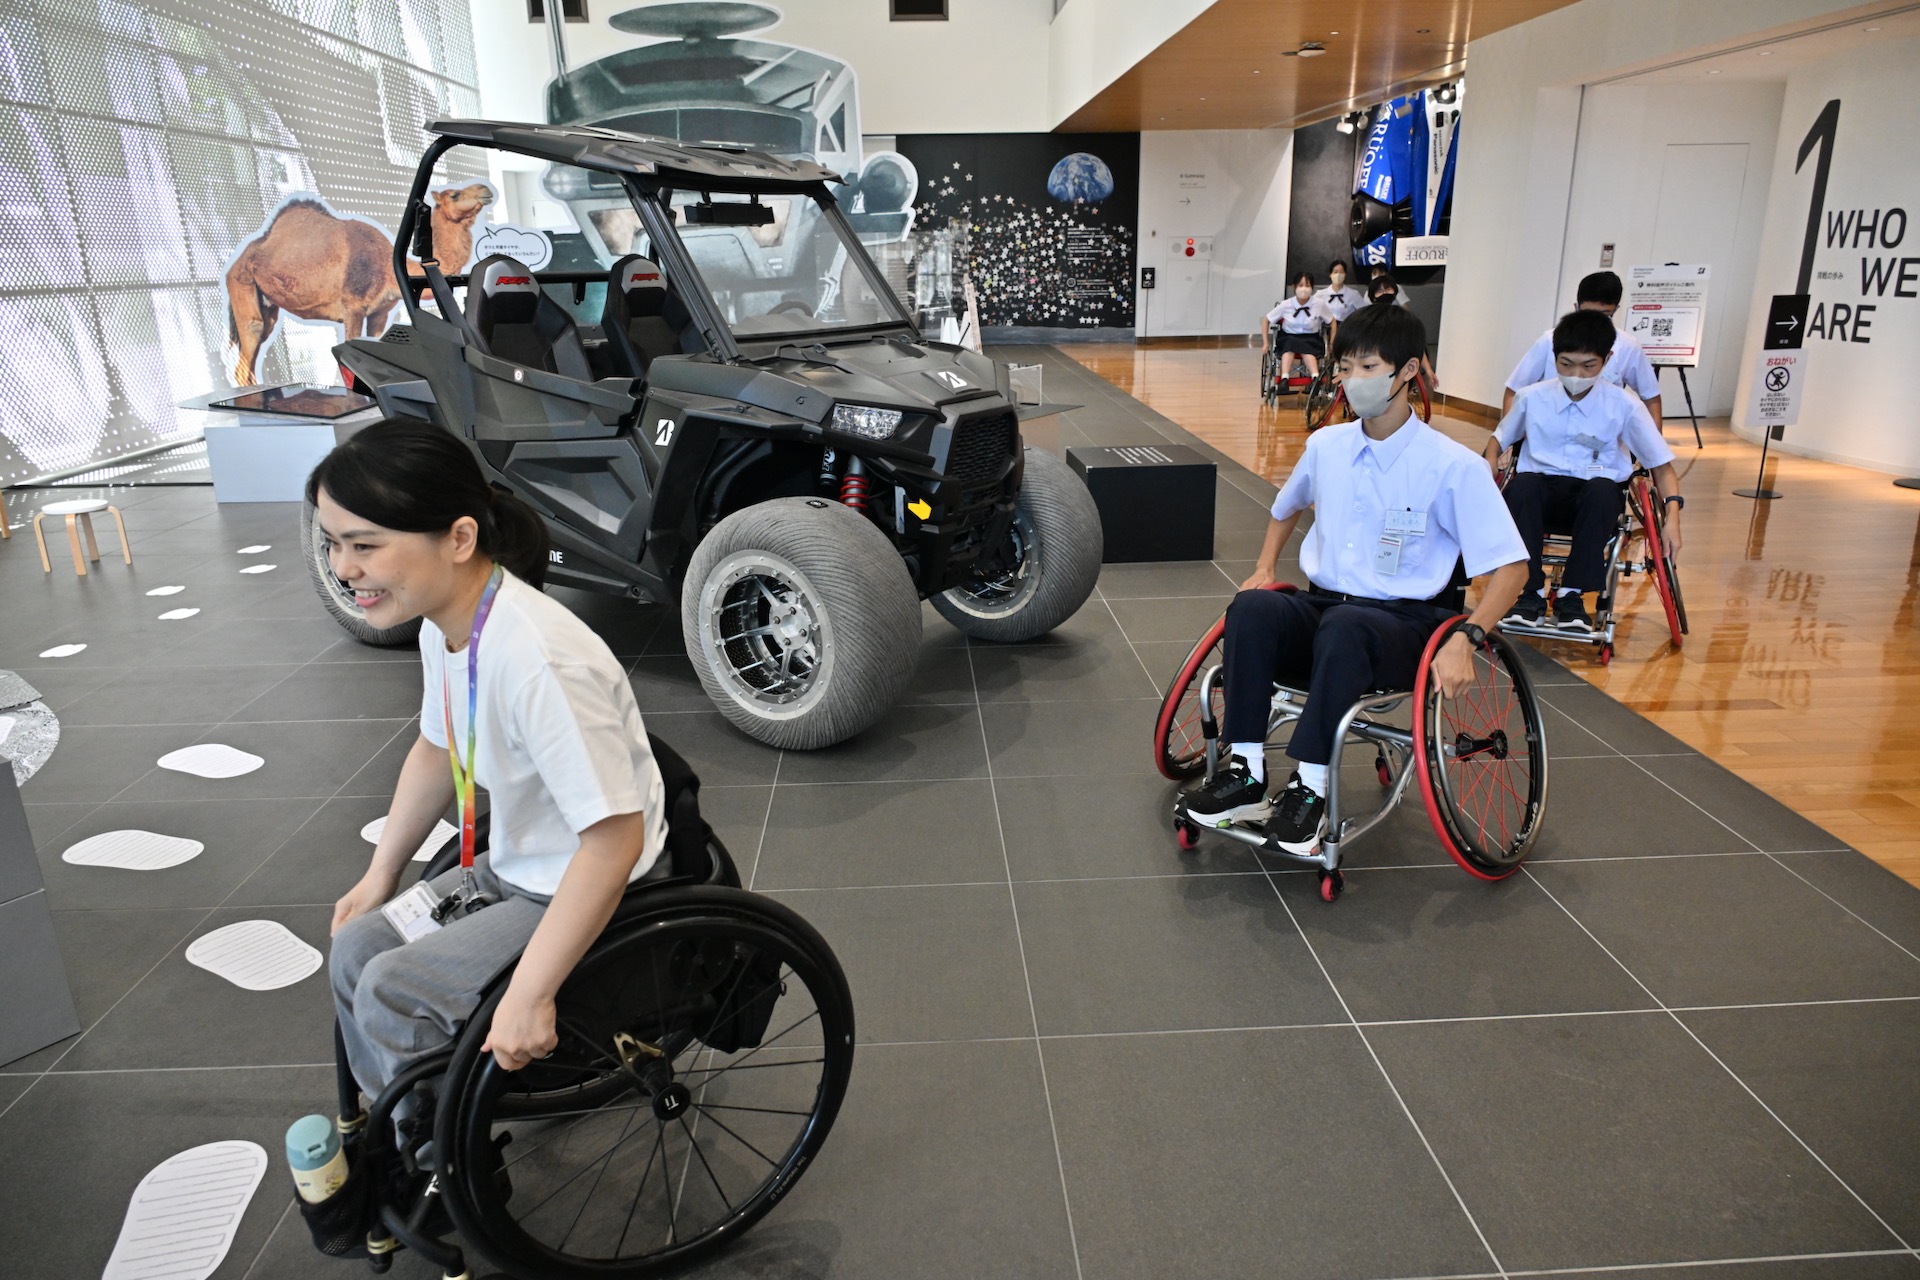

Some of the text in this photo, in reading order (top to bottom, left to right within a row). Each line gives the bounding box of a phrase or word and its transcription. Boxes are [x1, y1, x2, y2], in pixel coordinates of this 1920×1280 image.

[1827, 208, 1907, 249] WHO
[1368, 244, 1386, 265] 26
[1405, 249, 1445, 261] RUOFF
[1861, 257, 1920, 298] WE
[1806, 302, 1877, 343] ARE
[1766, 357, 1797, 366] おねがい
